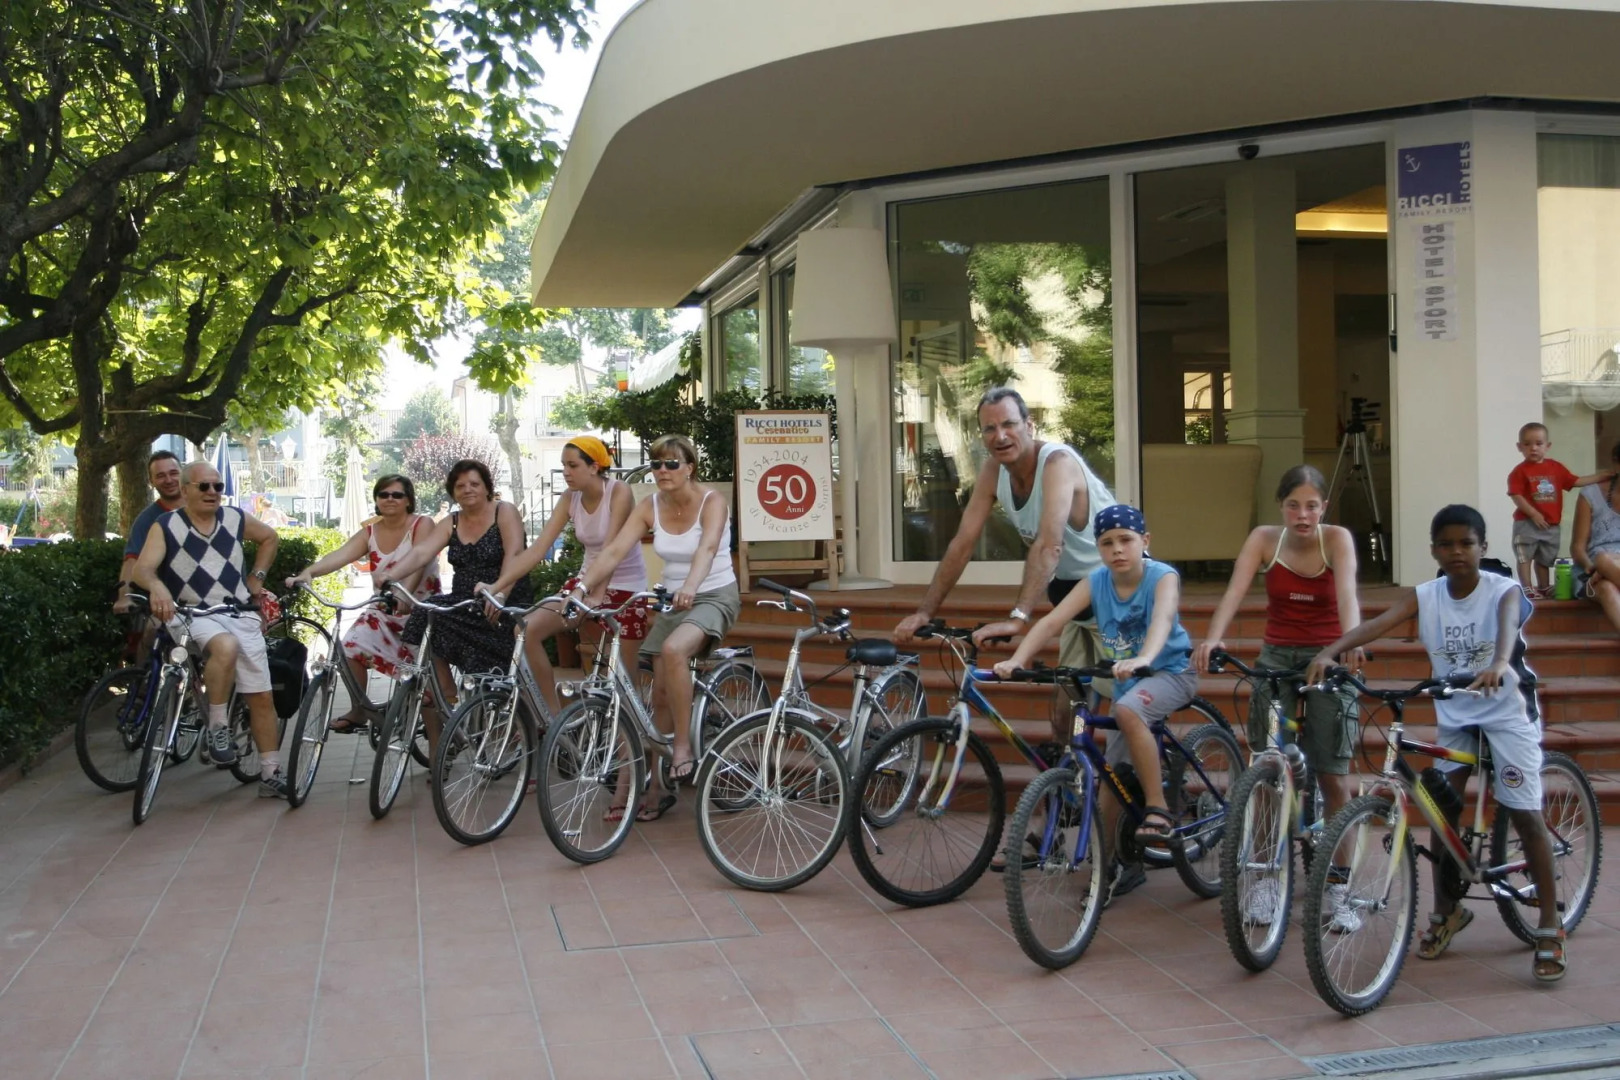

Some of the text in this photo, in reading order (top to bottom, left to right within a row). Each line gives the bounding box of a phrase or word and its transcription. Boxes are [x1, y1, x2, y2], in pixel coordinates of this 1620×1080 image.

[1460, 141, 1471, 203] HOTELS
[1399, 193, 1452, 210] RICCI
[1422, 224, 1446, 278] HOTEL
[1424, 285, 1447, 340] SPORT
[756, 426, 809, 435] Cesenatico
[744, 449, 809, 483] 1954-2004
[764, 474, 807, 505] 50
[749, 507, 759, 517] di
[762, 516, 810, 533] Vacanze
[785, 505, 804, 513] Anni
[1446, 637, 1477, 652] BALL
